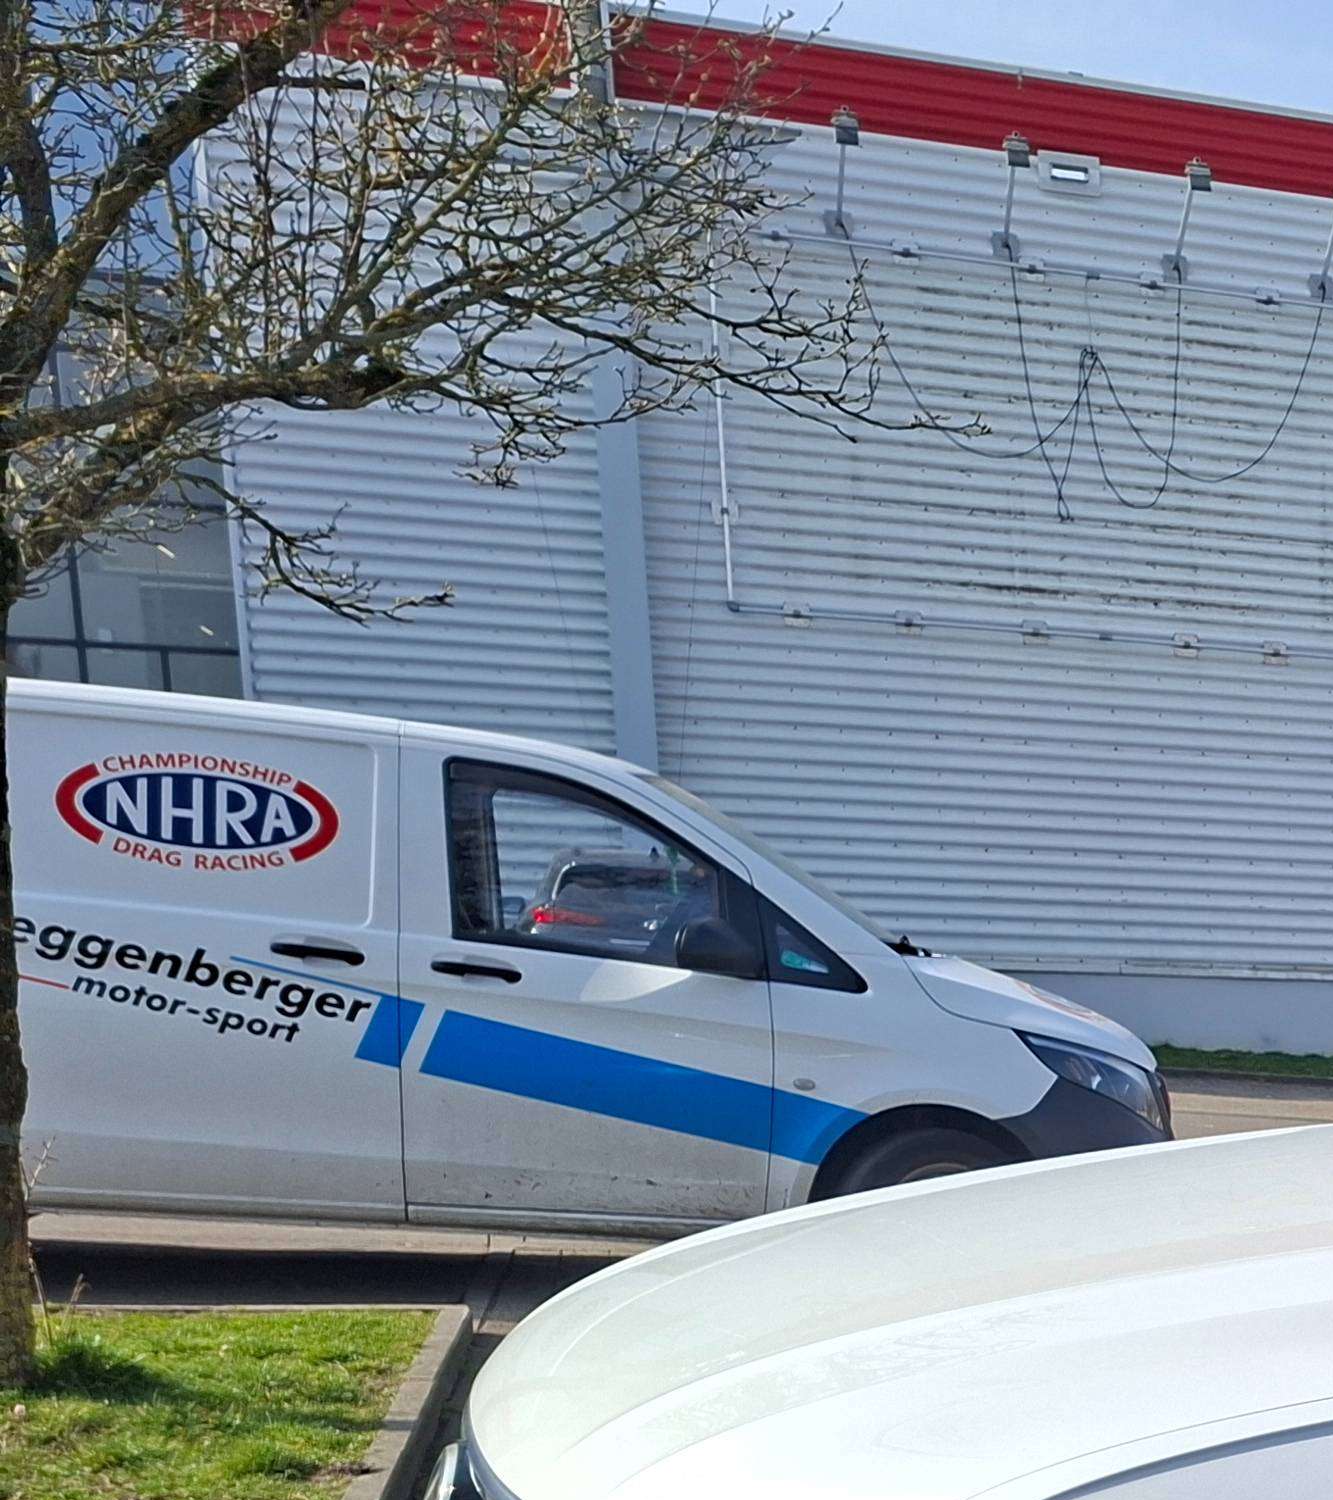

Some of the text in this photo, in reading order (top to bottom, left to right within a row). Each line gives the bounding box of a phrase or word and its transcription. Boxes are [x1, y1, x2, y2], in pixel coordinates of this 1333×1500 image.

[102, 753, 292, 787] CHAMPIONSHIP
[105, 775, 297, 847] NHRA
[112, 837, 284, 872] DRAG RACING
[12, 915, 372, 1024] eggenberger
[71, 975, 300, 1043] motor-sport
